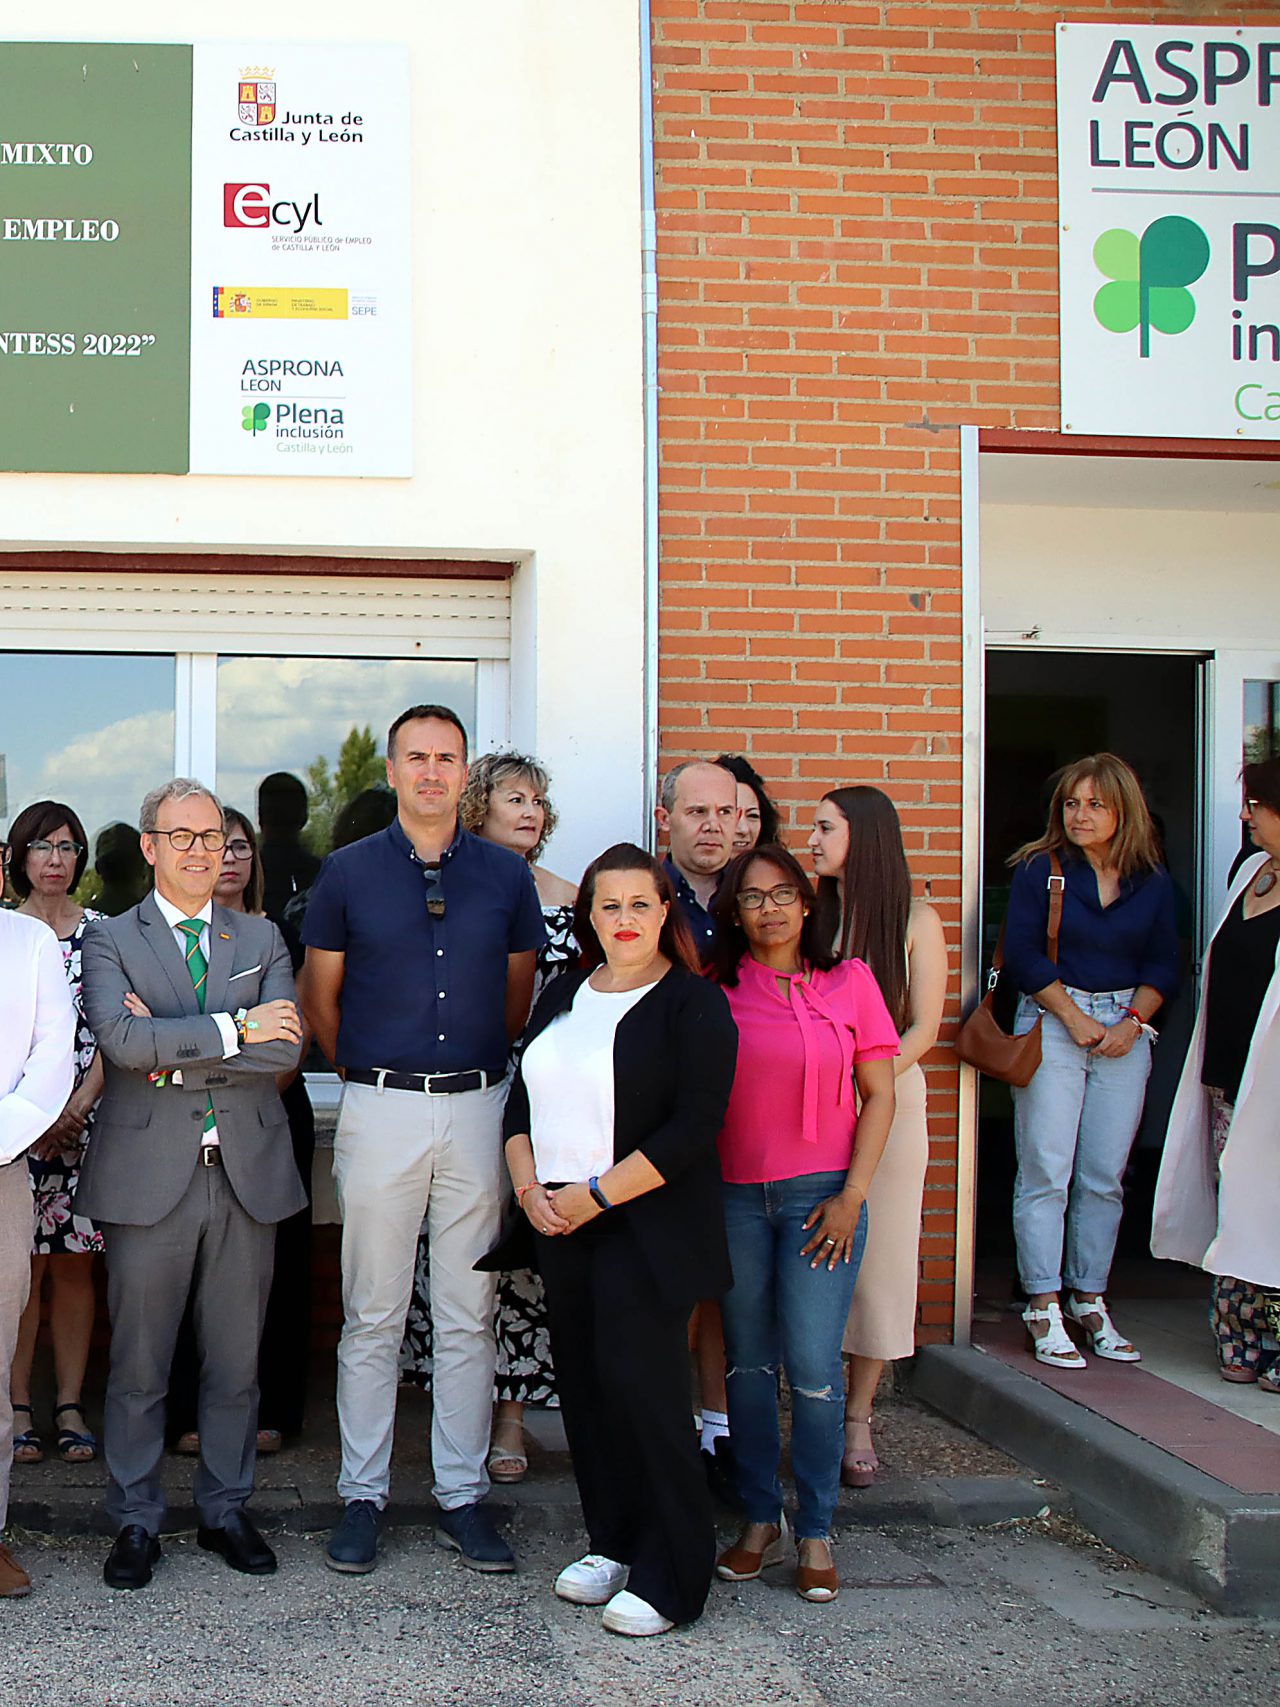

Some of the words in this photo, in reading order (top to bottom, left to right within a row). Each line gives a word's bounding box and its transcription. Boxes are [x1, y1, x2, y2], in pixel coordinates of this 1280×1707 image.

[282, 111, 333, 125] Junta
[341, 111, 363, 125] de
[229, 128, 294, 142] Castilla
[301, 132, 311, 145] y
[319, 128, 363, 143] León
[1089, 111, 1249, 171] LEÓN
[0, 143, 94, 165] MIXTO
[232, 184, 323, 233] ecyl
[2, 218, 121, 242] EMPLEO
[271, 235, 302, 243] SERVICIO
[335, 236, 344, 244] de
[351, 306, 377, 316] SEPE
[241, 359, 344, 377] ASPRONA
[276, 403, 344, 424] Plena
[276, 425, 344, 439] inclusión
[276, 442, 316, 454] Castilla
[318, 445, 326, 456] y
[327, 442, 354, 454] León
